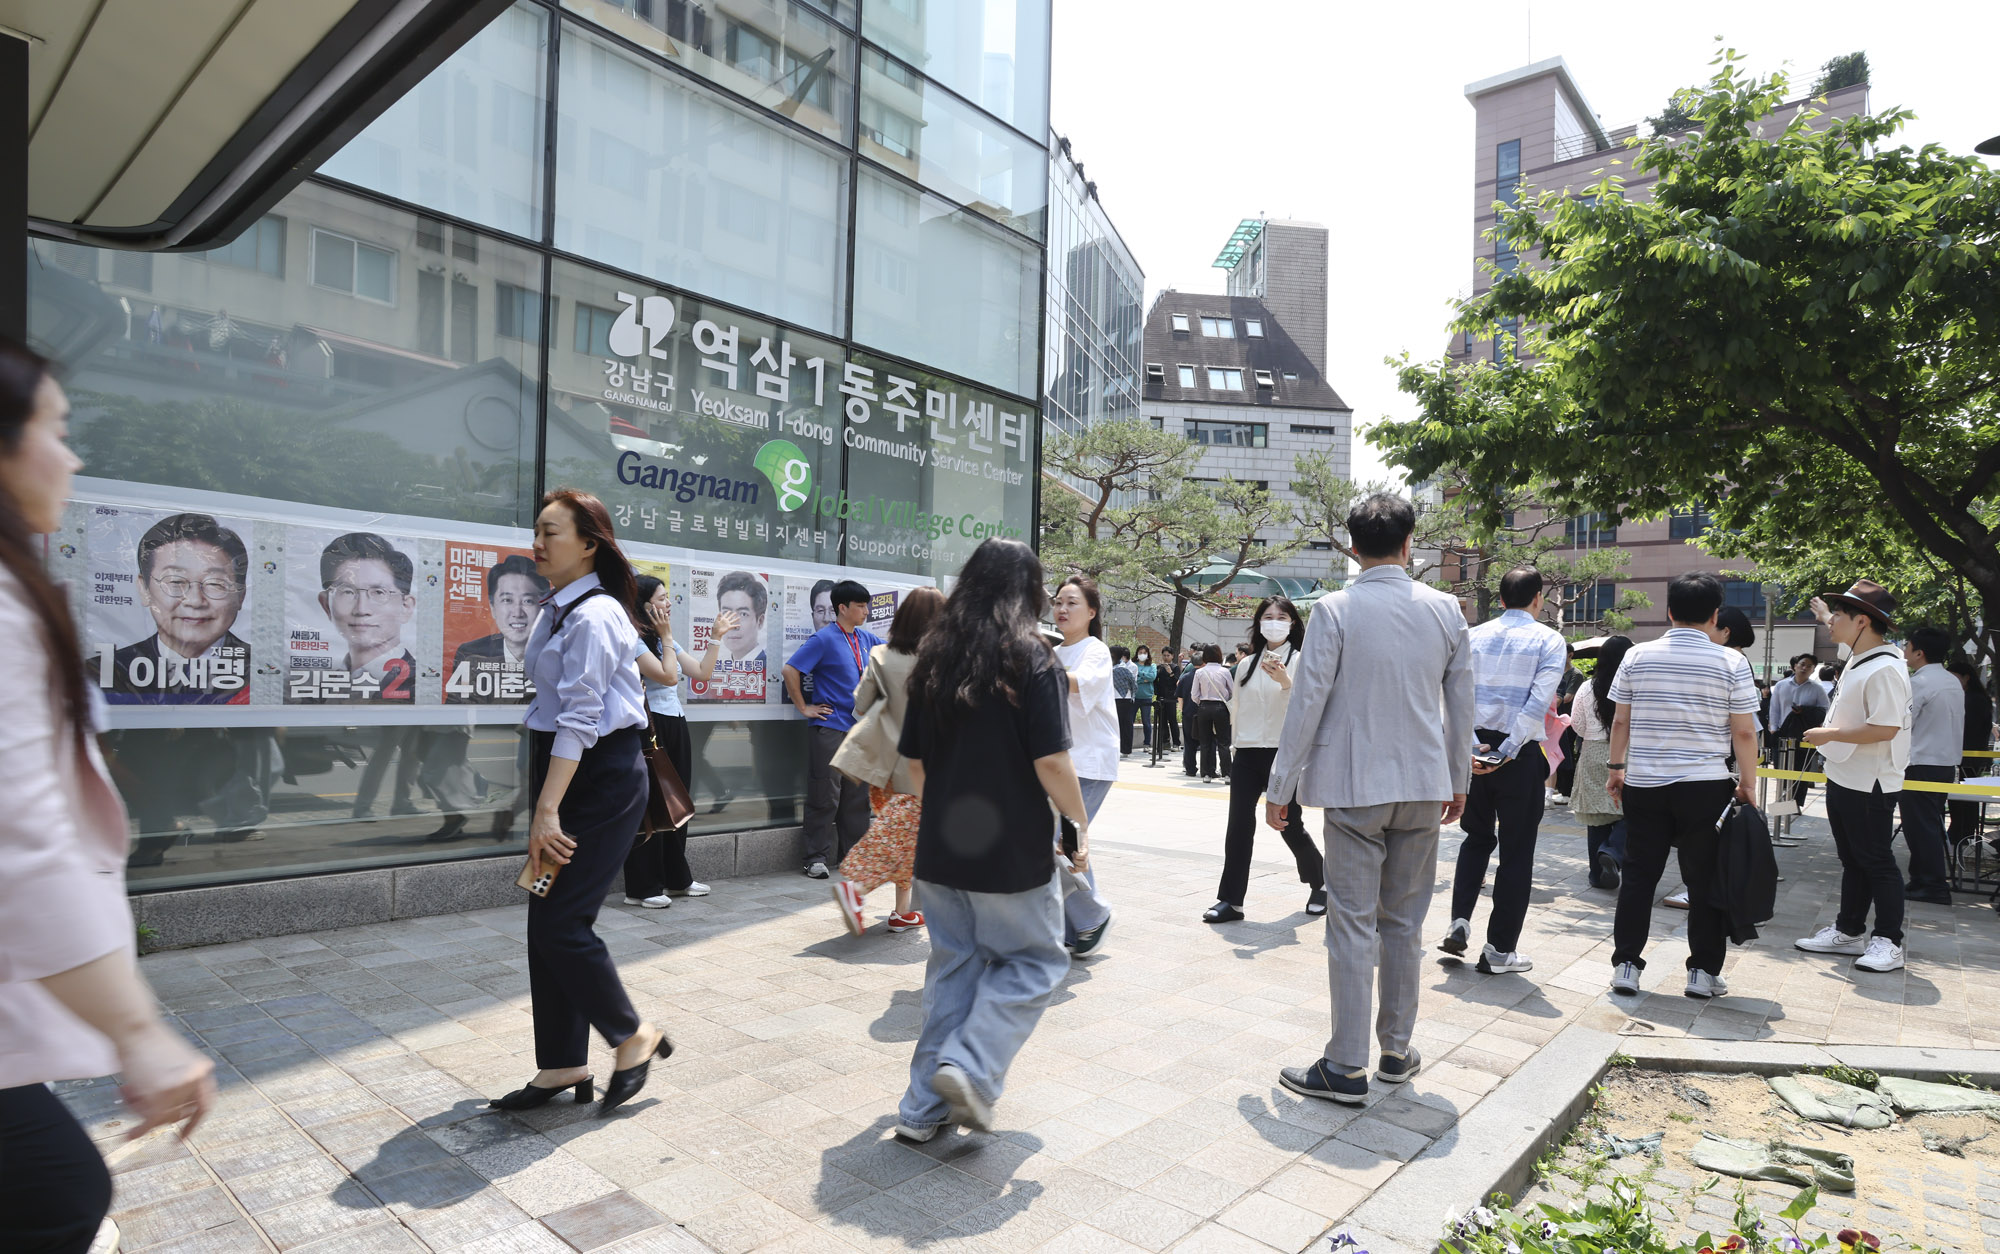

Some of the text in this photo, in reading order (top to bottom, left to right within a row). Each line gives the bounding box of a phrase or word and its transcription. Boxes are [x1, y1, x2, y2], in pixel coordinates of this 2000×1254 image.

[604, 359, 675, 397] 강남구
[692, 320, 1027, 462] 역삼1동주민센터
[691, 388, 1024, 486] Yeoksam 1-dong Community Service Center
[617, 450, 759, 505] Gangnam
[879, 498, 954, 541] Village
[450, 547, 498, 568] 미래를
[849, 534, 907, 557] Support
[911, 543, 956, 564] Center
[94, 572, 133, 583] 이제부터
[449, 565, 482, 584] 여는
[94, 584, 115, 593] 진짜
[449, 583, 482, 602] 선택
[94, 595, 133, 605] 대한민국
[871, 605, 895, 619] 후정치!
[290, 630, 320, 640] 새롭게
[210, 646, 246, 658] 지금은
[290, 641, 329, 651] 대한민국
[129, 656, 246, 690] 이재명
[476, 661, 500, 671] 새로운
[735, 660, 763, 671] 대통령
[289, 658, 411, 699] 김문수 2
[445, 660, 474, 698] 4
[711, 672, 765, 697] 구주와
